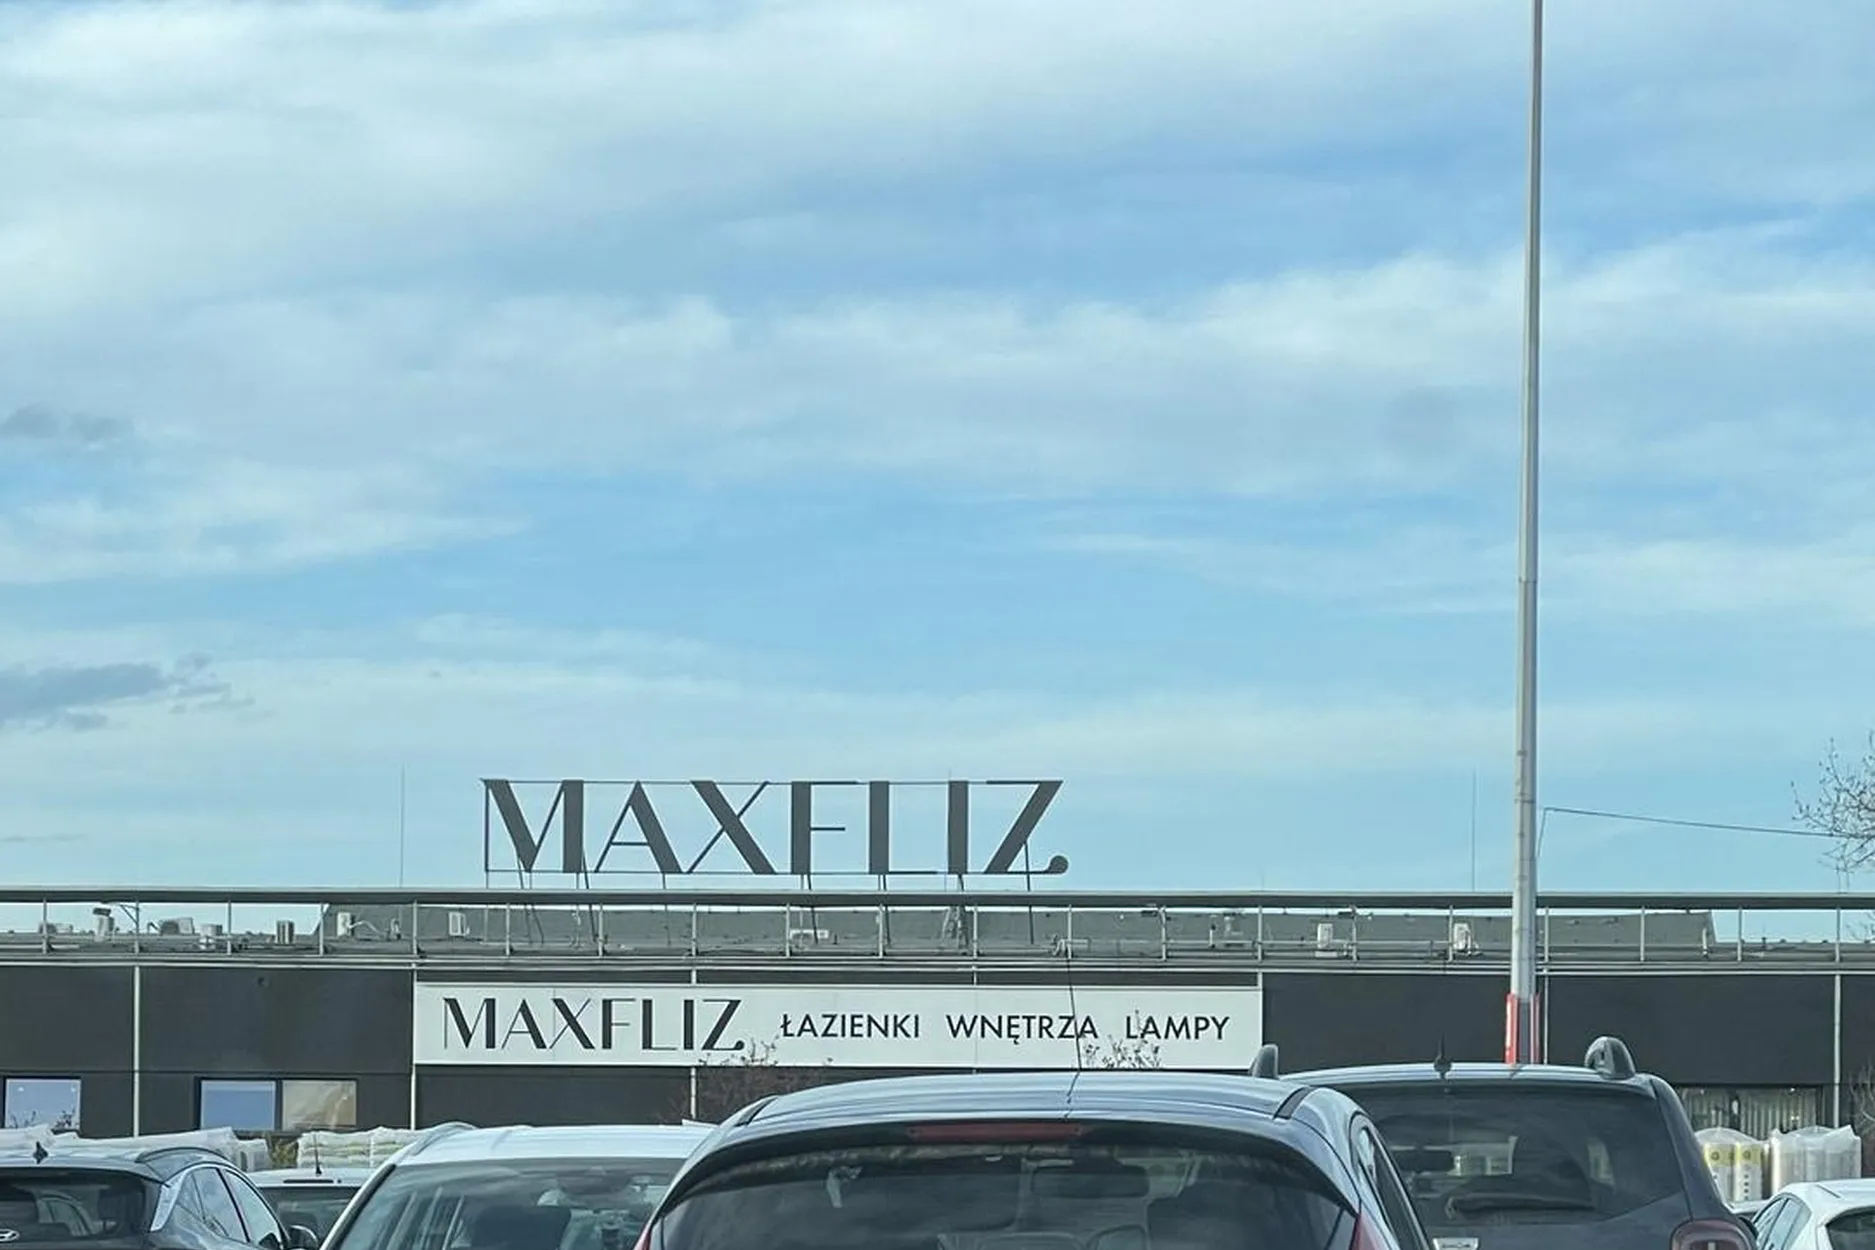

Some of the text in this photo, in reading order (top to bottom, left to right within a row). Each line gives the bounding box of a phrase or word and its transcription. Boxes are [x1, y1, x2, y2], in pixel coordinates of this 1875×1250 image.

[483, 779, 1068, 874] MAXFLIZ
[443, 998, 1230, 1051] MAXFLIZ ŁAZIENKI WNĘTRZA LAMPY
